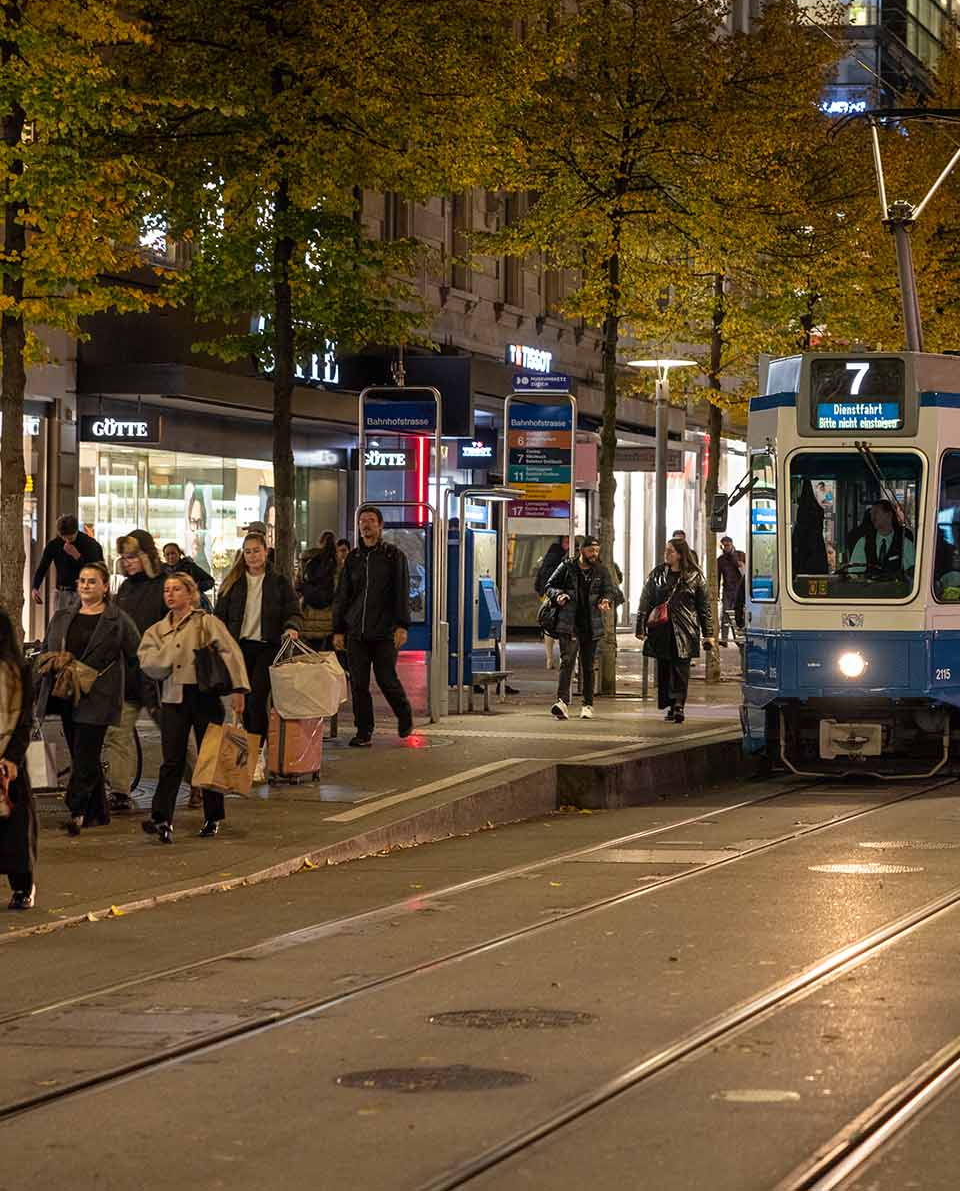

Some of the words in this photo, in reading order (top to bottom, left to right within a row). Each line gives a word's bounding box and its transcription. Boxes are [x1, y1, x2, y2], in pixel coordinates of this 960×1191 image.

[846, 362, 869, 395] 7
[833, 403, 882, 415] Dienstfahrt
[92, 417, 148, 437] GÖTTE
[367, 417, 429, 426] Bahnhofstrasse
[511, 419, 566, 427] Bahnhofstrasse
[819, 417, 836, 428] Bitte
[838, 417, 857, 428] nicht
[518, 436, 524, 447] 6
[517, 454, 524, 464] 7
[514, 472, 524, 482] 11
[512, 506, 523, 516] 17
[936, 669, 951, 680] 2115
